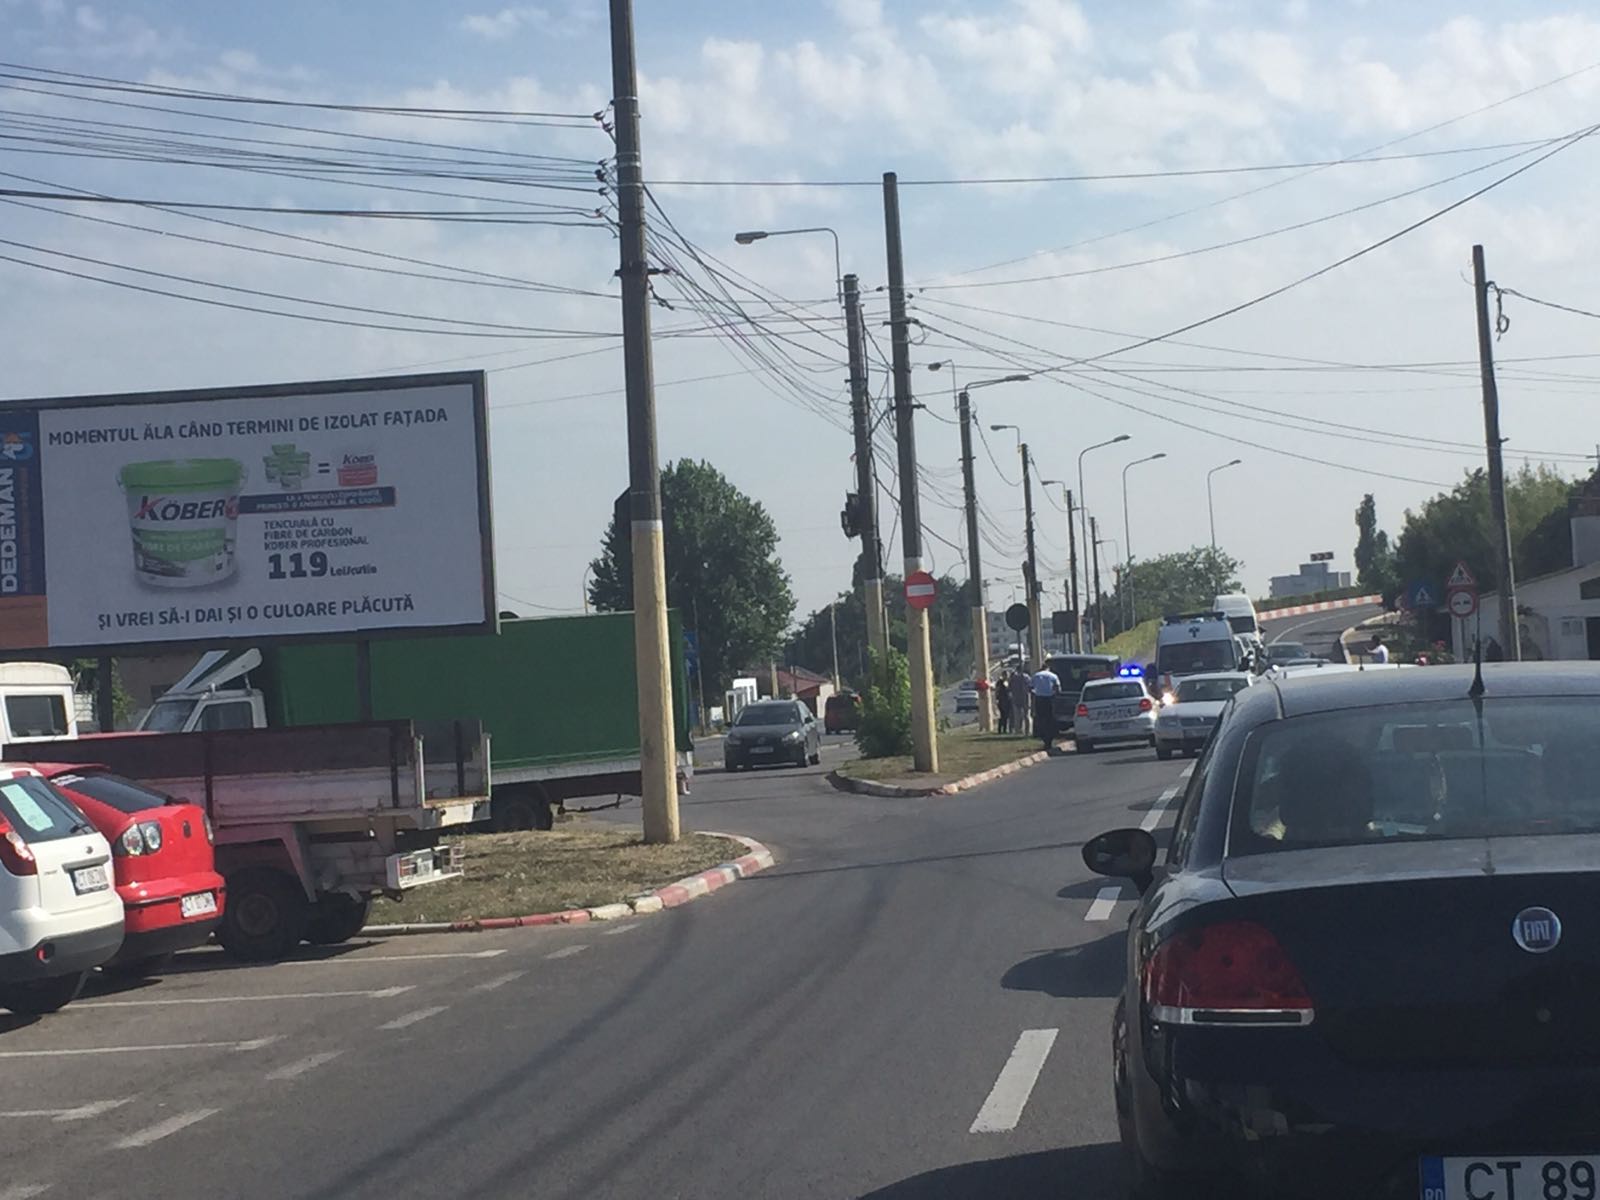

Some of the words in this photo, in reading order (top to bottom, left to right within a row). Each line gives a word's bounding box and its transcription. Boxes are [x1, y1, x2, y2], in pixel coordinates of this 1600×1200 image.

[49, 428, 138, 445] MOMENTUL
[143, 423, 174, 440] ĂLA
[178, 420, 222, 438] CÂND
[227, 418, 293, 435] TERMINI
[298, 416, 319, 431] DE
[325, 412, 378, 429] IZOLAT
[0, 467, 17, 593] DEDEMAN
[295, 529, 308, 538] DE
[321, 517, 334, 527] CU
[269, 551, 328, 579] 119
[116, 612, 153, 626] VREI
[158, 607, 190, 625] SĂ-I
[195, 608, 223, 623] DAI
[247, 605, 258, 620] O
[263, 601, 336, 618] CULOARE
[342, 593, 415, 614] PLĂCUTĂ
[1523, 919, 1551, 942] FIAT
[1464, 1161, 1522, 1200] CT
